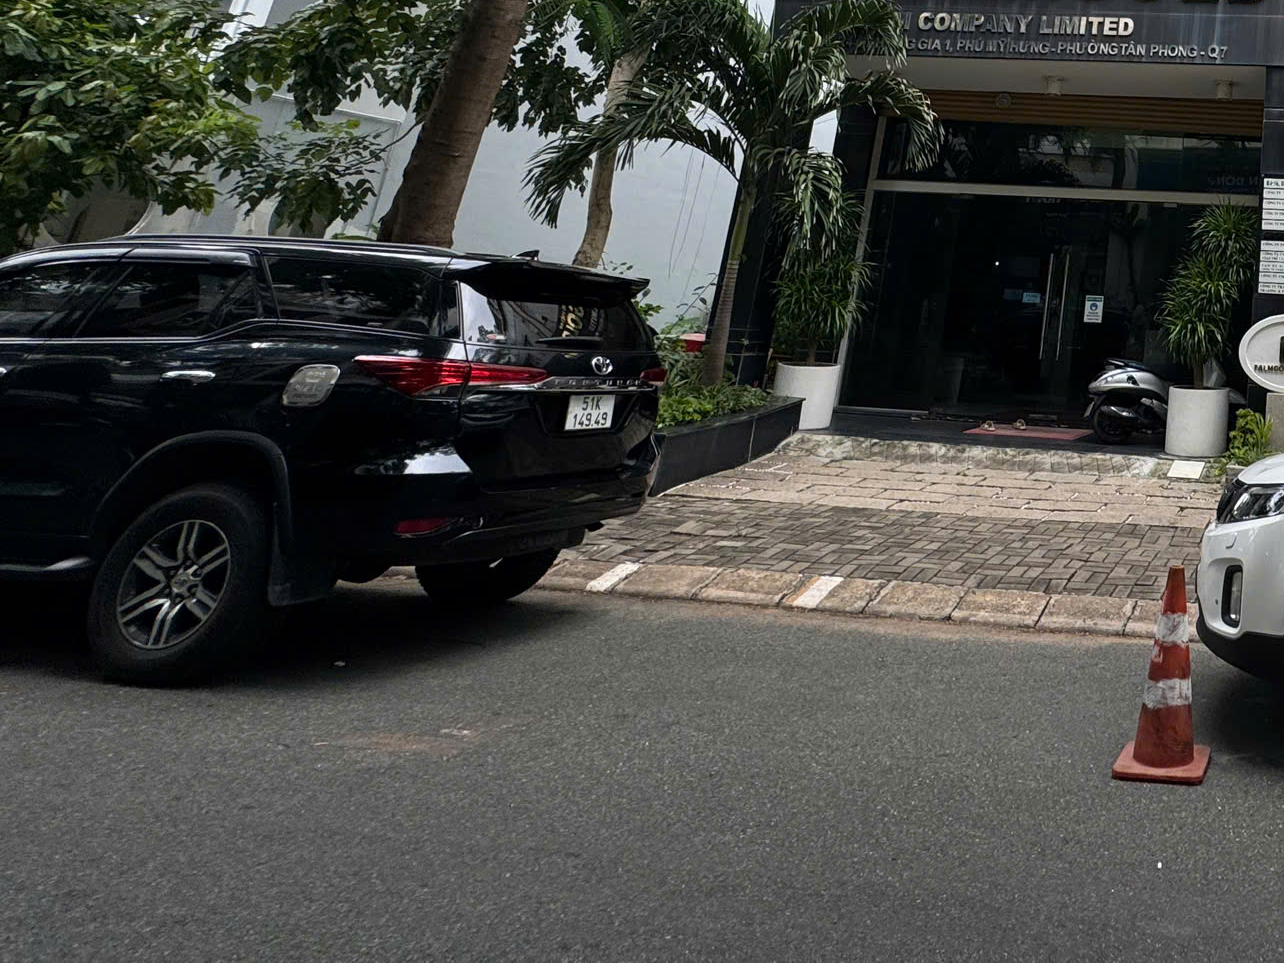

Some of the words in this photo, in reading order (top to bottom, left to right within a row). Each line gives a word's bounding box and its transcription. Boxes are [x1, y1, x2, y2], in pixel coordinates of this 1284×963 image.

[918, 11, 1033, 35] COMPANY
[1039, 15, 1135, 36] LIMITED
[918, 38, 941, 51] GIA
[957, 37, 985, 52] PHÚ
[1120, 40, 1146, 56] TÂN
[1150, 44, 1198, 58] PHONG
[582, 396, 603, 411] 51K
[573, 412, 608, 428] 149.49
